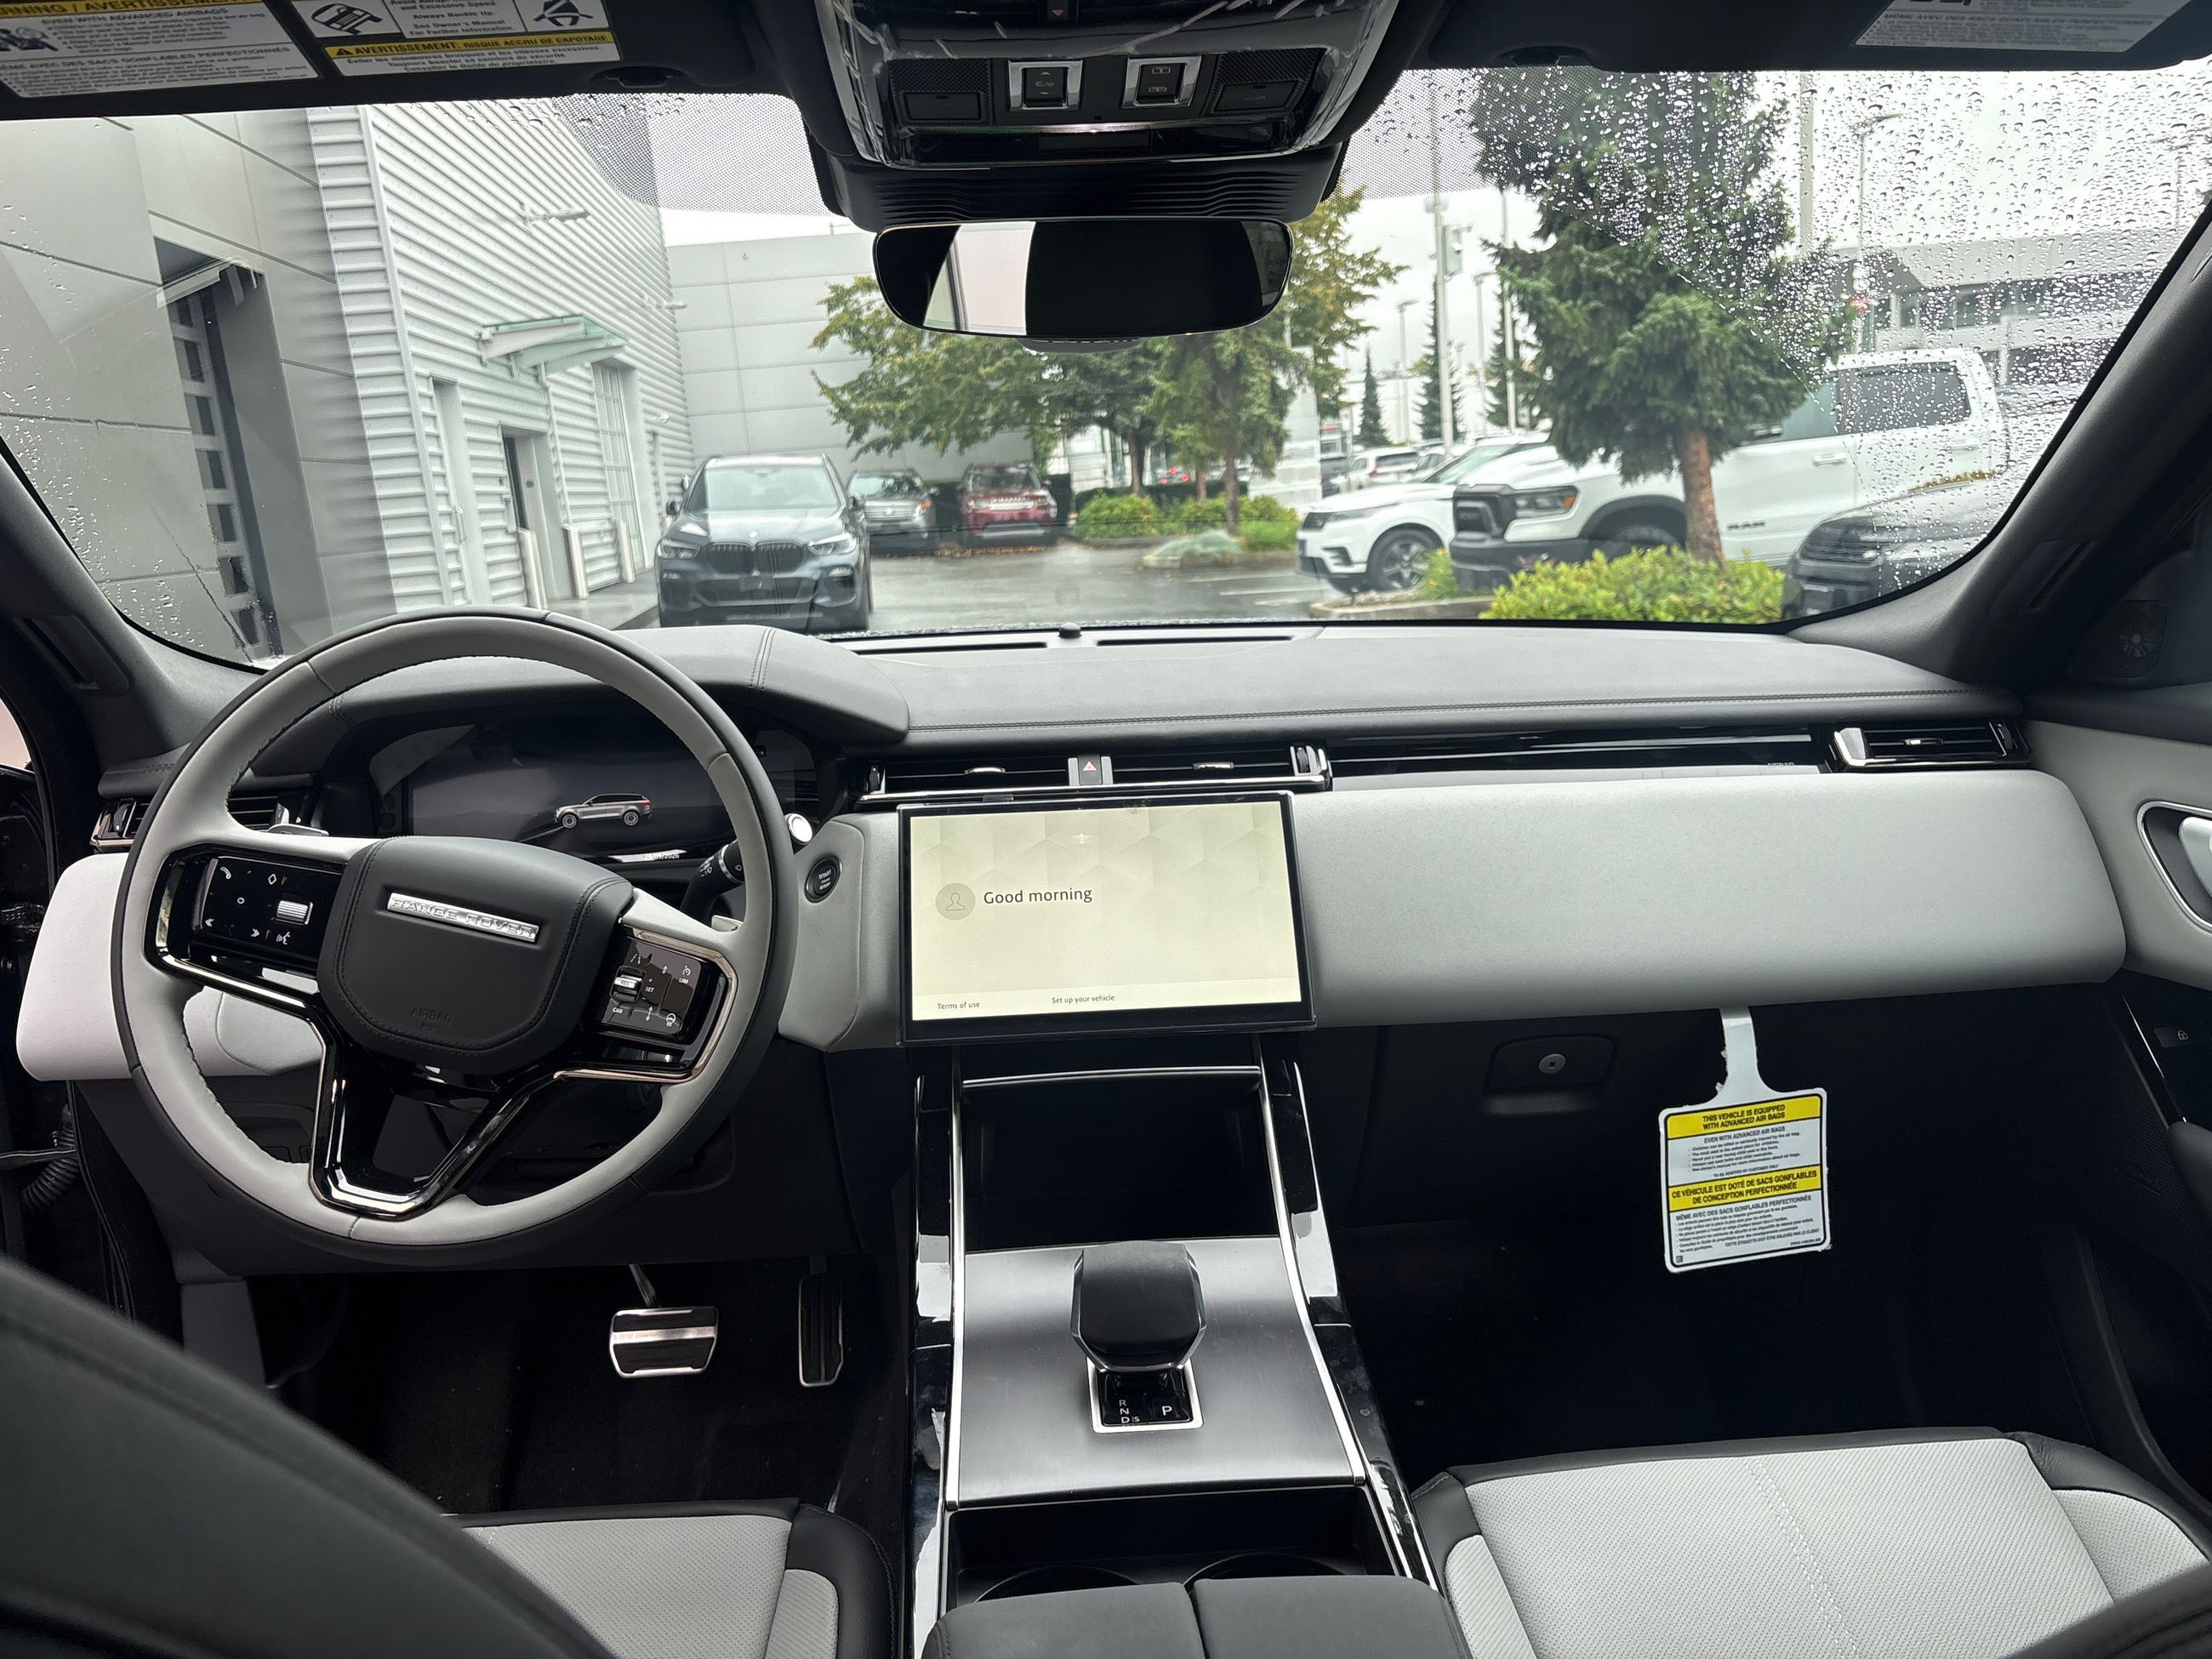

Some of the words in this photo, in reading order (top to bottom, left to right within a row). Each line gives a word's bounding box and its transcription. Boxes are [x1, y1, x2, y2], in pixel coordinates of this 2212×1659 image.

[983, 890, 1023, 904] Good
[1029, 887, 1092, 904] morning
[392, 896, 459, 921] RANGE
[465, 913, 536, 938] ROVER
[1075, 996, 1090, 1005] your
[1092, 995, 1115, 1003] vehicle
[1718, 1110, 1746, 1120] VEHICLE
[1753, 1104, 1786, 1115] EQUIPPED
[1720, 1117, 1755, 1128] ADVANCED
[1768, 1112, 1786, 1120] BAGS
[1732, 1130, 1760, 1139] ADVANCED
[1681, 1185, 1713, 1197] VÉHICULE
[1714, 1183, 1727, 1192] EST
[1728, 1180, 1745, 1190] DOTÉ
[1756, 1177, 1774, 1185] SACS
[1775, 1171, 1817, 1183] GONFLABLES
[1702, 1190, 1744, 1203] CONCEPTION
[1745, 1182, 1797, 1197] PERFECTIONNÉE
[1734, 1202, 1769, 1212] GONFLABLES
[1769, 1194, 1811, 1206] PERFECTIONNÉS
[1120, 1407, 1130, 1416] N
[1161, 1405, 1172, 1417] P
